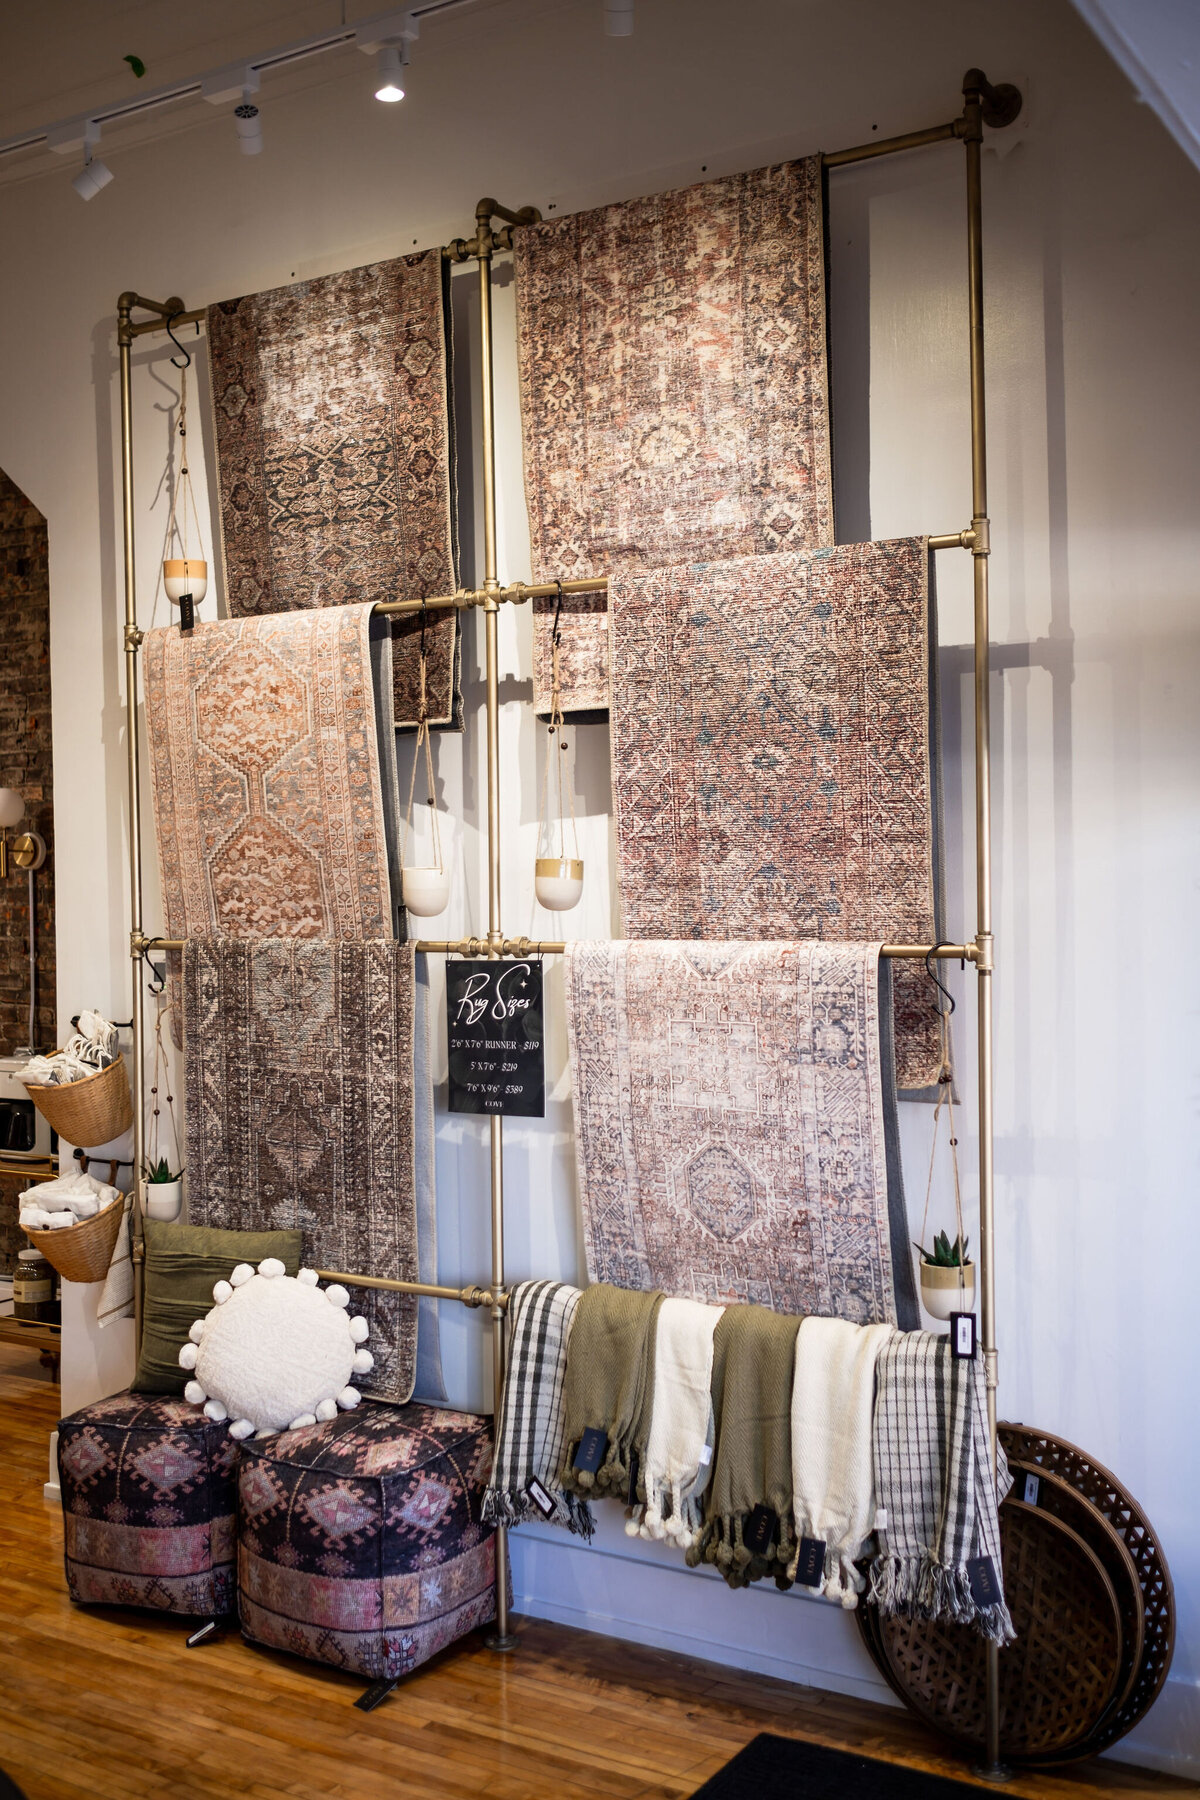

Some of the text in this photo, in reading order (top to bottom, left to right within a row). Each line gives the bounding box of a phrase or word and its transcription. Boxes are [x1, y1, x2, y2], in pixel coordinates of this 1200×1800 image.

[457, 963, 531, 1025] Rug Sizes
[485, 1040, 517, 1050] RUNNER
